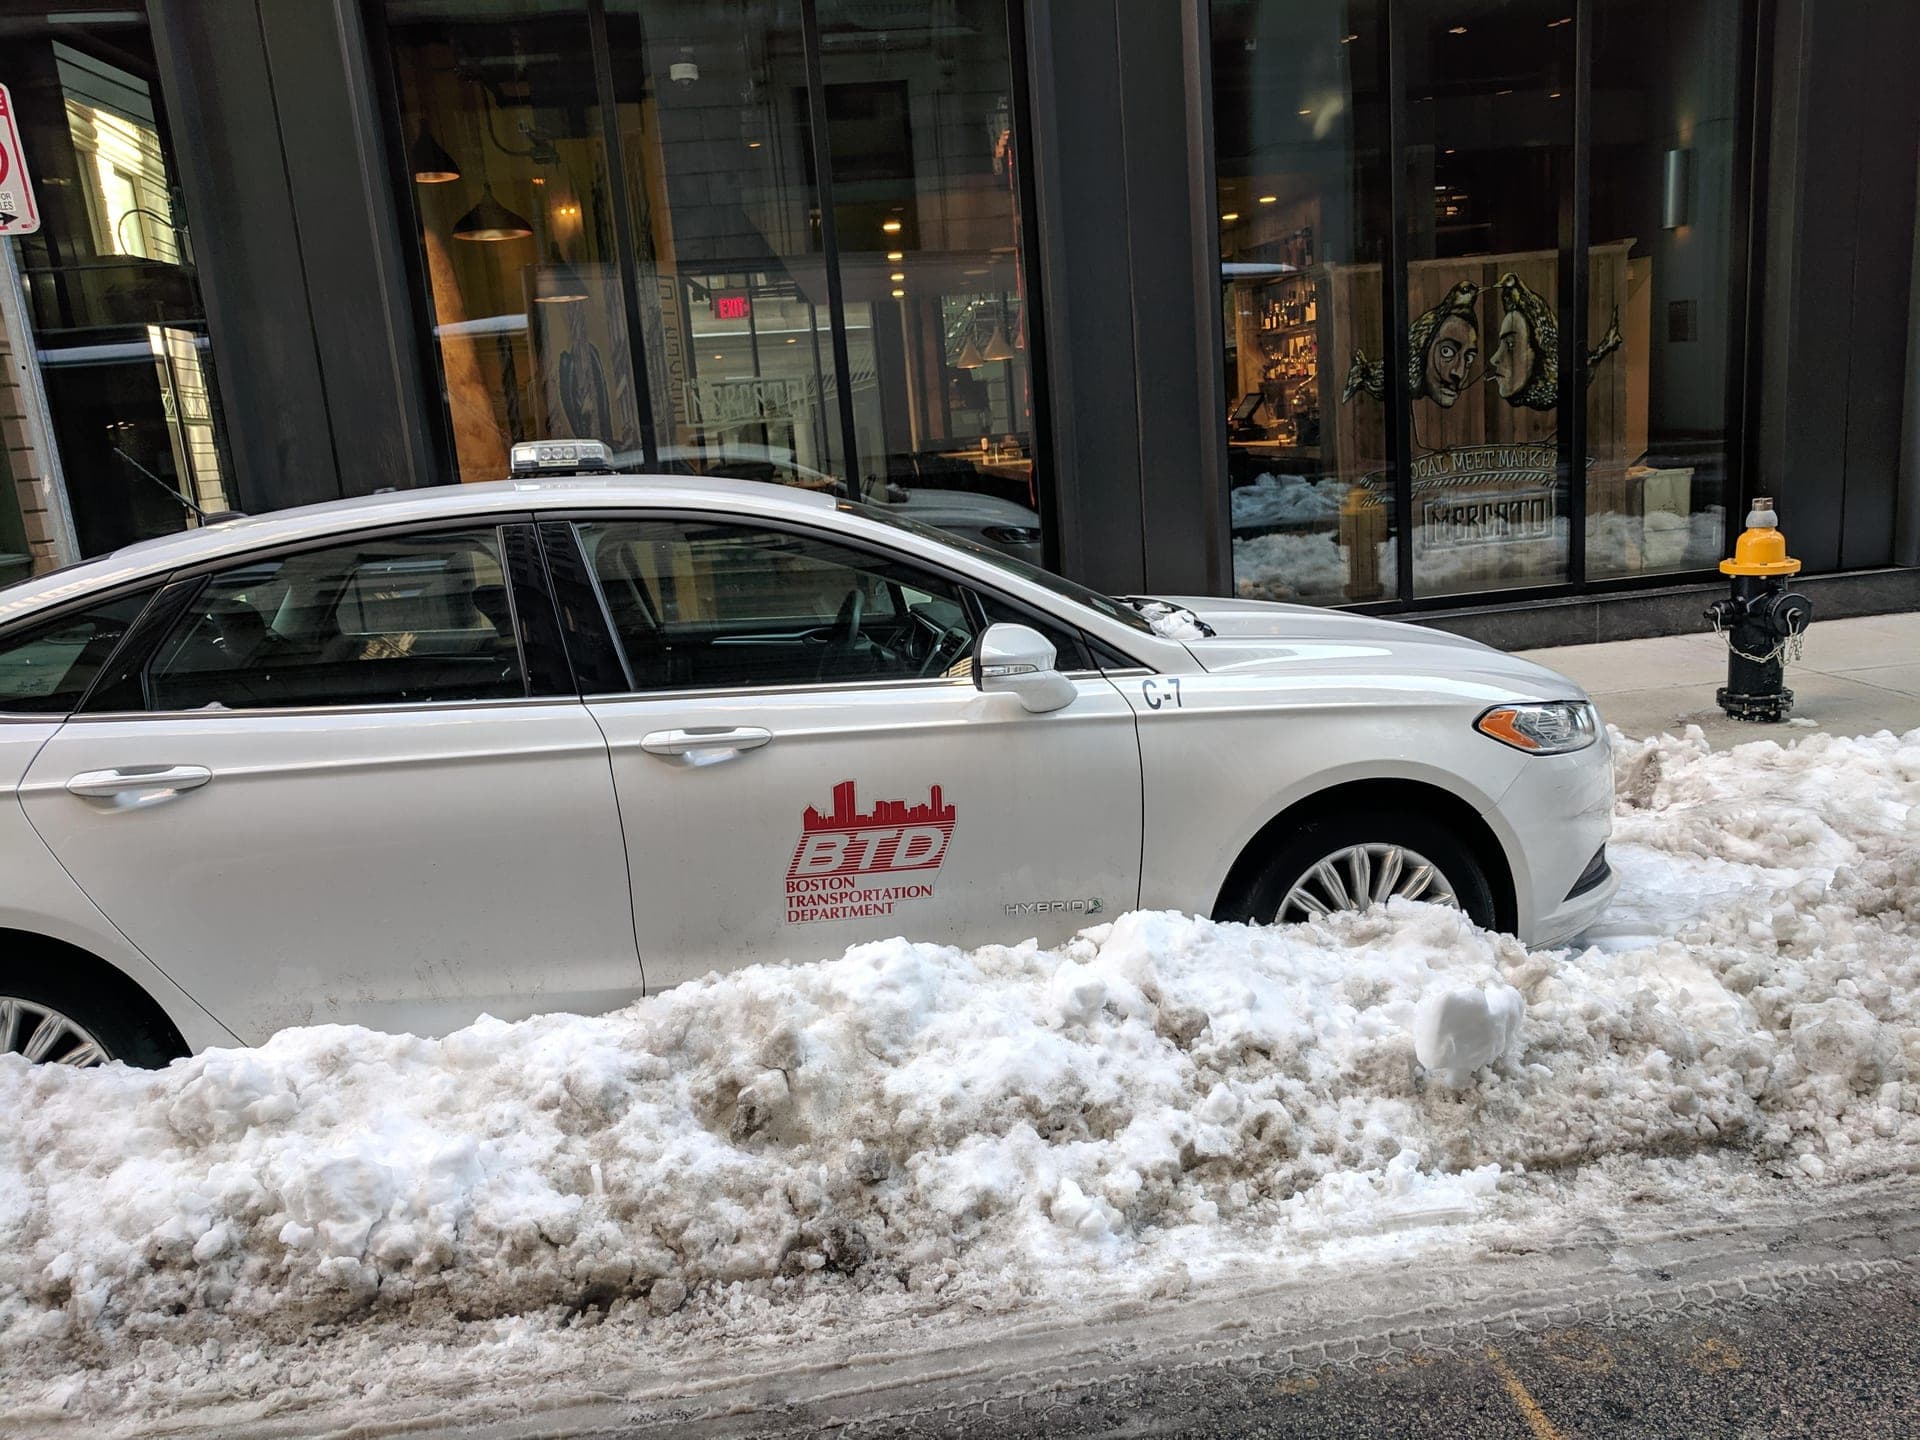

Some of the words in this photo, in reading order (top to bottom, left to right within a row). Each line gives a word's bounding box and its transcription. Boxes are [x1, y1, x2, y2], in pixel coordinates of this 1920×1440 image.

[719, 296, 744, 319] EXIT
[1410, 455, 1449, 481] OCAL
[1452, 450, 1495, 473] MEET
[1142, 678, 1182, 710] C-7
[794, 826, 946, 876] BTD
[786, 876, 855, 894] BOSTON
[786, 884, 933, 908] TRANSPORTATION
[787, 902, 895, 923] DEPARTMENT
[1005, 900, 1085, 916] HYBRID
